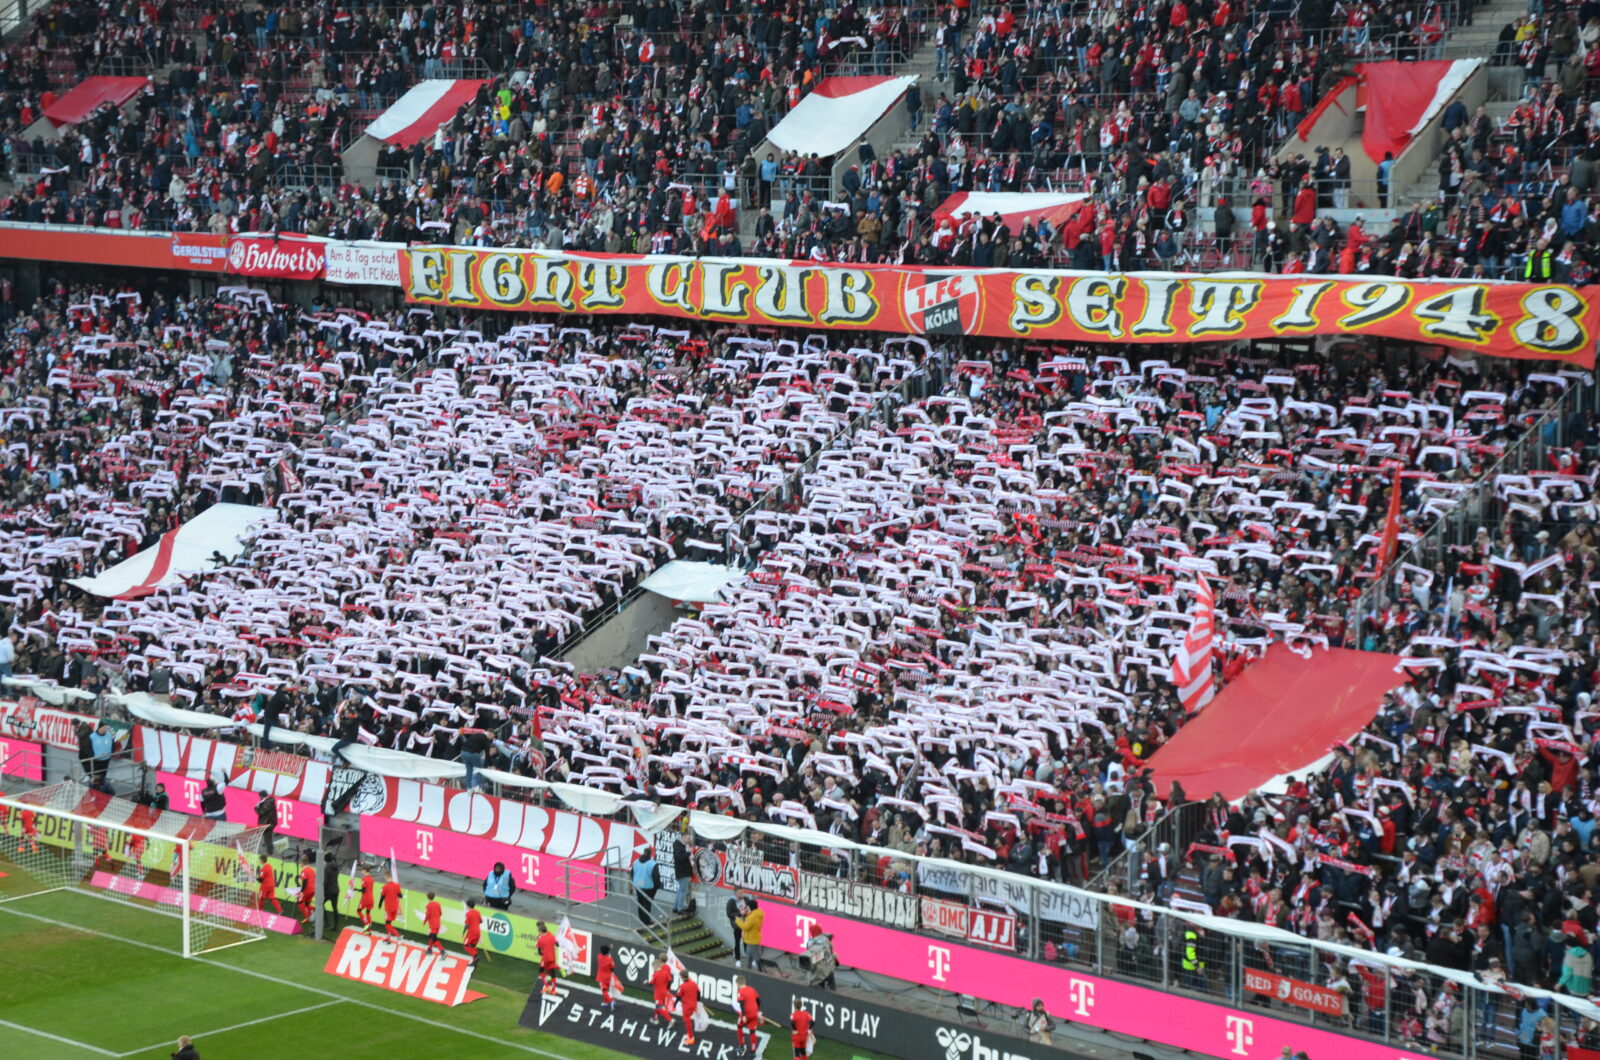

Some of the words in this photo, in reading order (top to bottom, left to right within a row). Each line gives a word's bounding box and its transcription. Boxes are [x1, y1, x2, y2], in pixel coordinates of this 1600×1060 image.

[172, 245, 227, 258] GEROLSTEIN
[244, 242, 325, 272] Holweide
[330, 248, 344, 261] Am
[354, 249, 369, 266] Tag
[371, 250, 397, 265] schuf
[344, 267, 360, 280] den
[380, 267, 399, 281] Köln
[410, 251, 629, 312] FIGHT
[648, 261, 880, 325] CLUB
[924, 307, 959, 331] KÖLN
[1011, 273, 1263, 337] SEIT
[1271, 280, 1588, 353] 1948
[724, 858, 796, 899] COLONIACS
[800, 873, 918, 930] VEEDELSRADAU
[486, 918, 507, 934] VRS
[971, 914, 1011, 944] AJJ
[335, 932, 459, 1003] REWE
[1246, 973, 1272, 991] RED
[1293, 986, 1341, 1010] GOATS
[566, 1002, 736, 1060] STAHLWERK
[840, 1009, 881, 1039] PLAY
